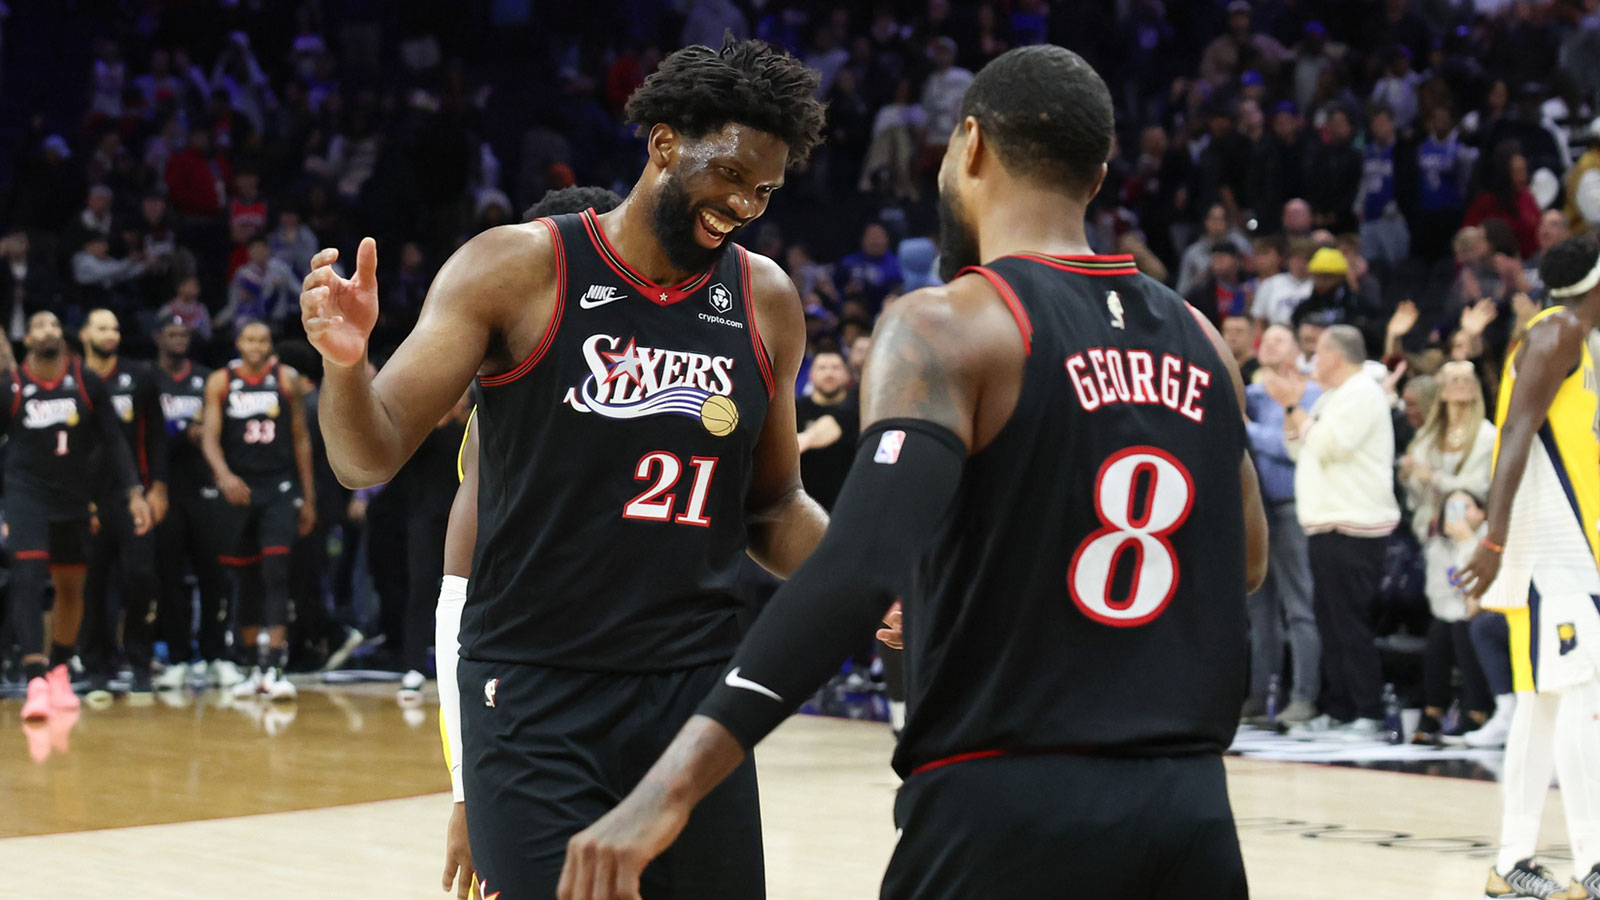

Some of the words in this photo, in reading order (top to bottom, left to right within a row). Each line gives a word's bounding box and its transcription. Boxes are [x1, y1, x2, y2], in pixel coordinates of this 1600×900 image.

[586, 284, 618, 300] NIKE
[698, 312, 743, 329] crypto.com
[1065, 347, 1211, 424] GEORGE
[55, 430, 70, 456] 1
[244, 419, 276, 444] 33
[622, 450, 719, 528] 21
[1066, 445, 1196, 627] 8
